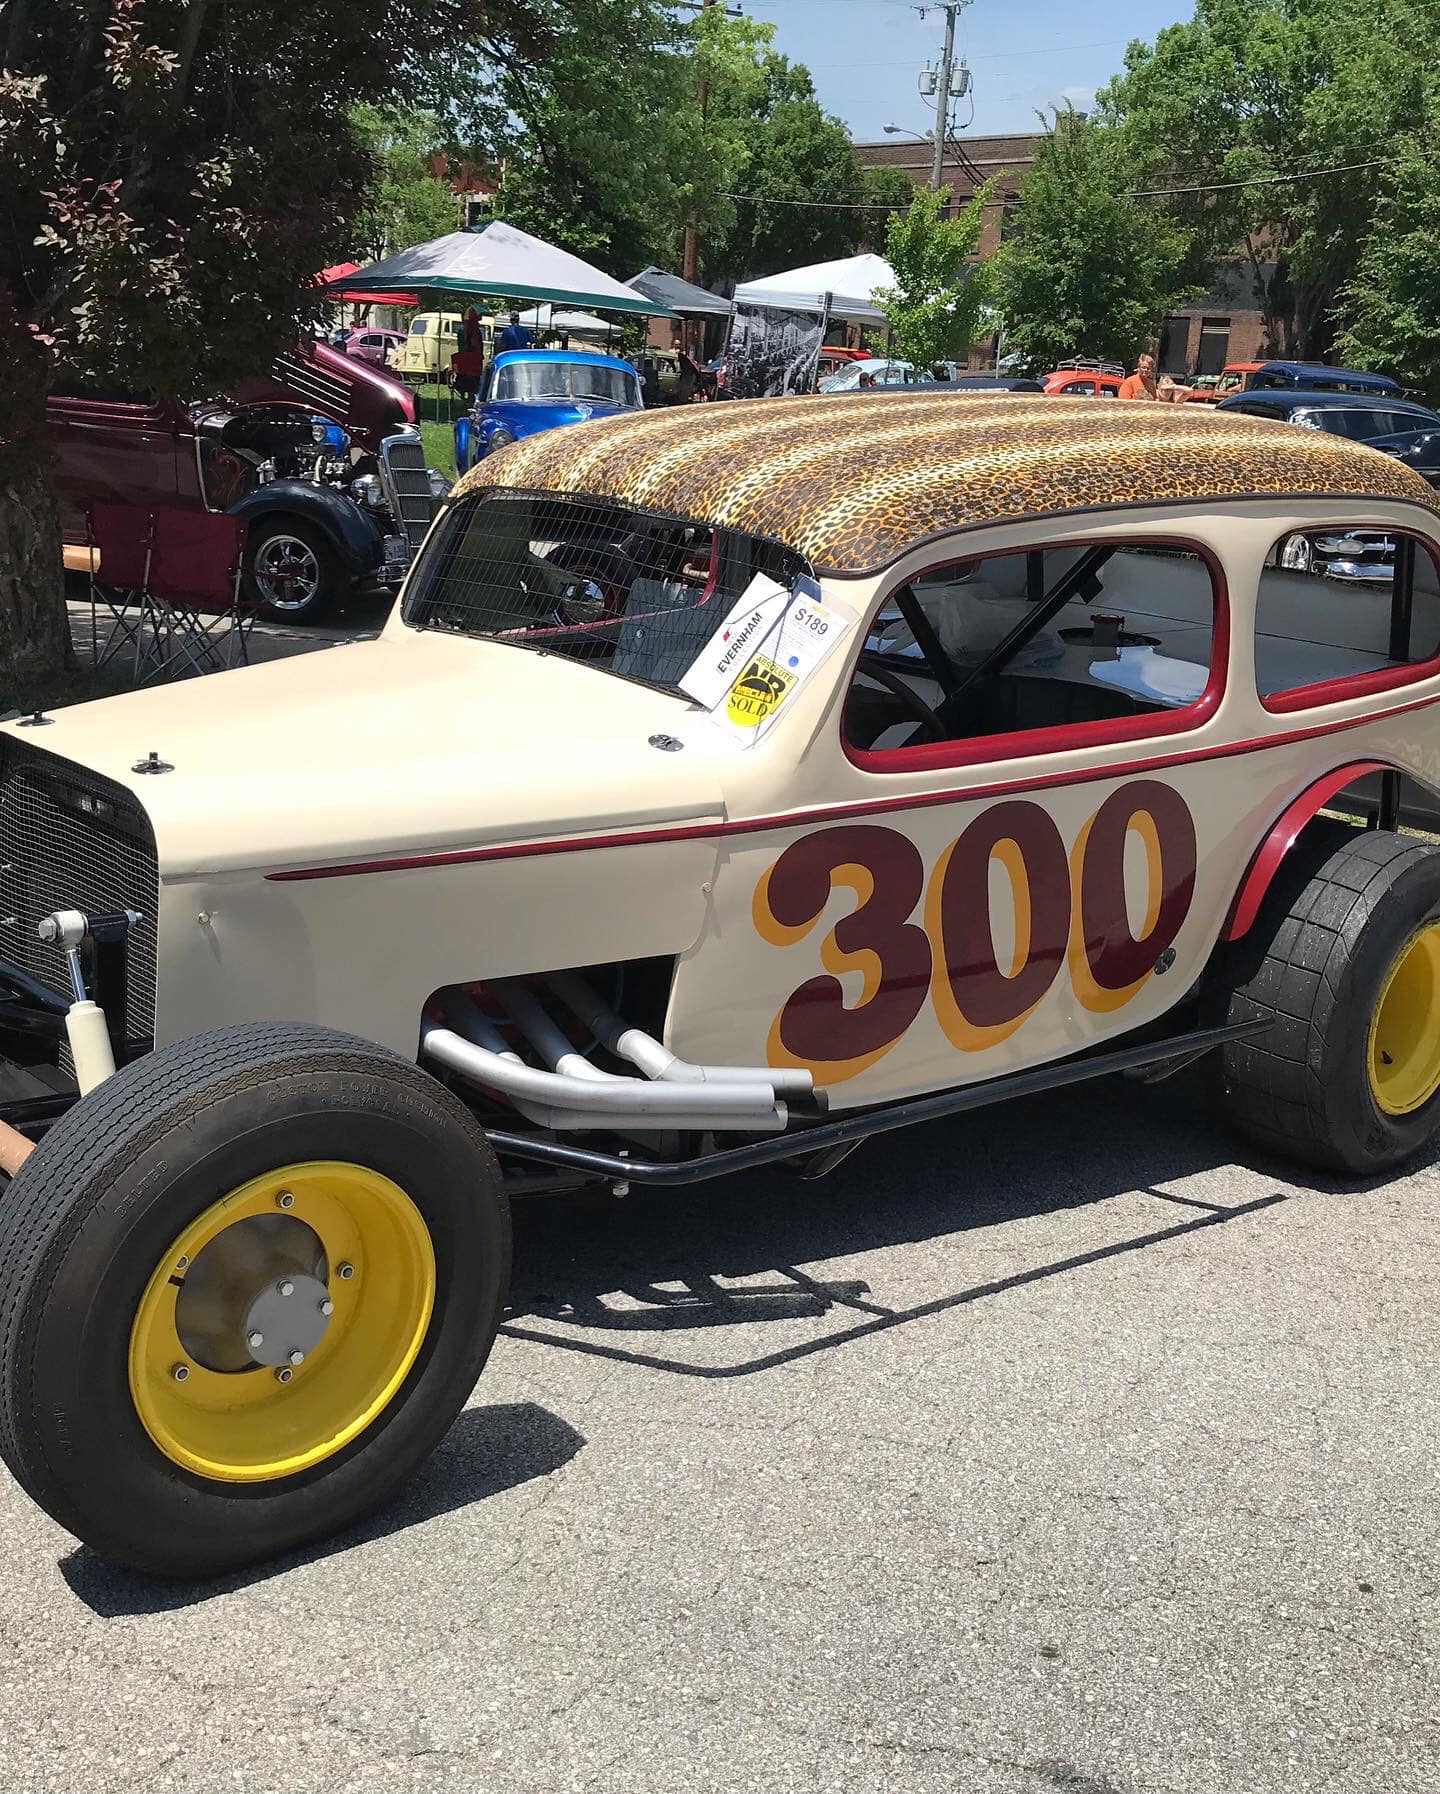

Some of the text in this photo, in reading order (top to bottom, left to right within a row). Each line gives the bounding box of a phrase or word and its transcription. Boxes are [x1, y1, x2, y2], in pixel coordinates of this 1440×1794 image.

[717, 612, 763, 673] EVERNHAM
[795, 608, 828, 635] S189
[756, 656, 794, 682] ABSOLUTE
[728, 694, 768, 717] SOLD
[752, 779, 1197, 1087] 300
[113, 1160, 168, 1219] BELTED
